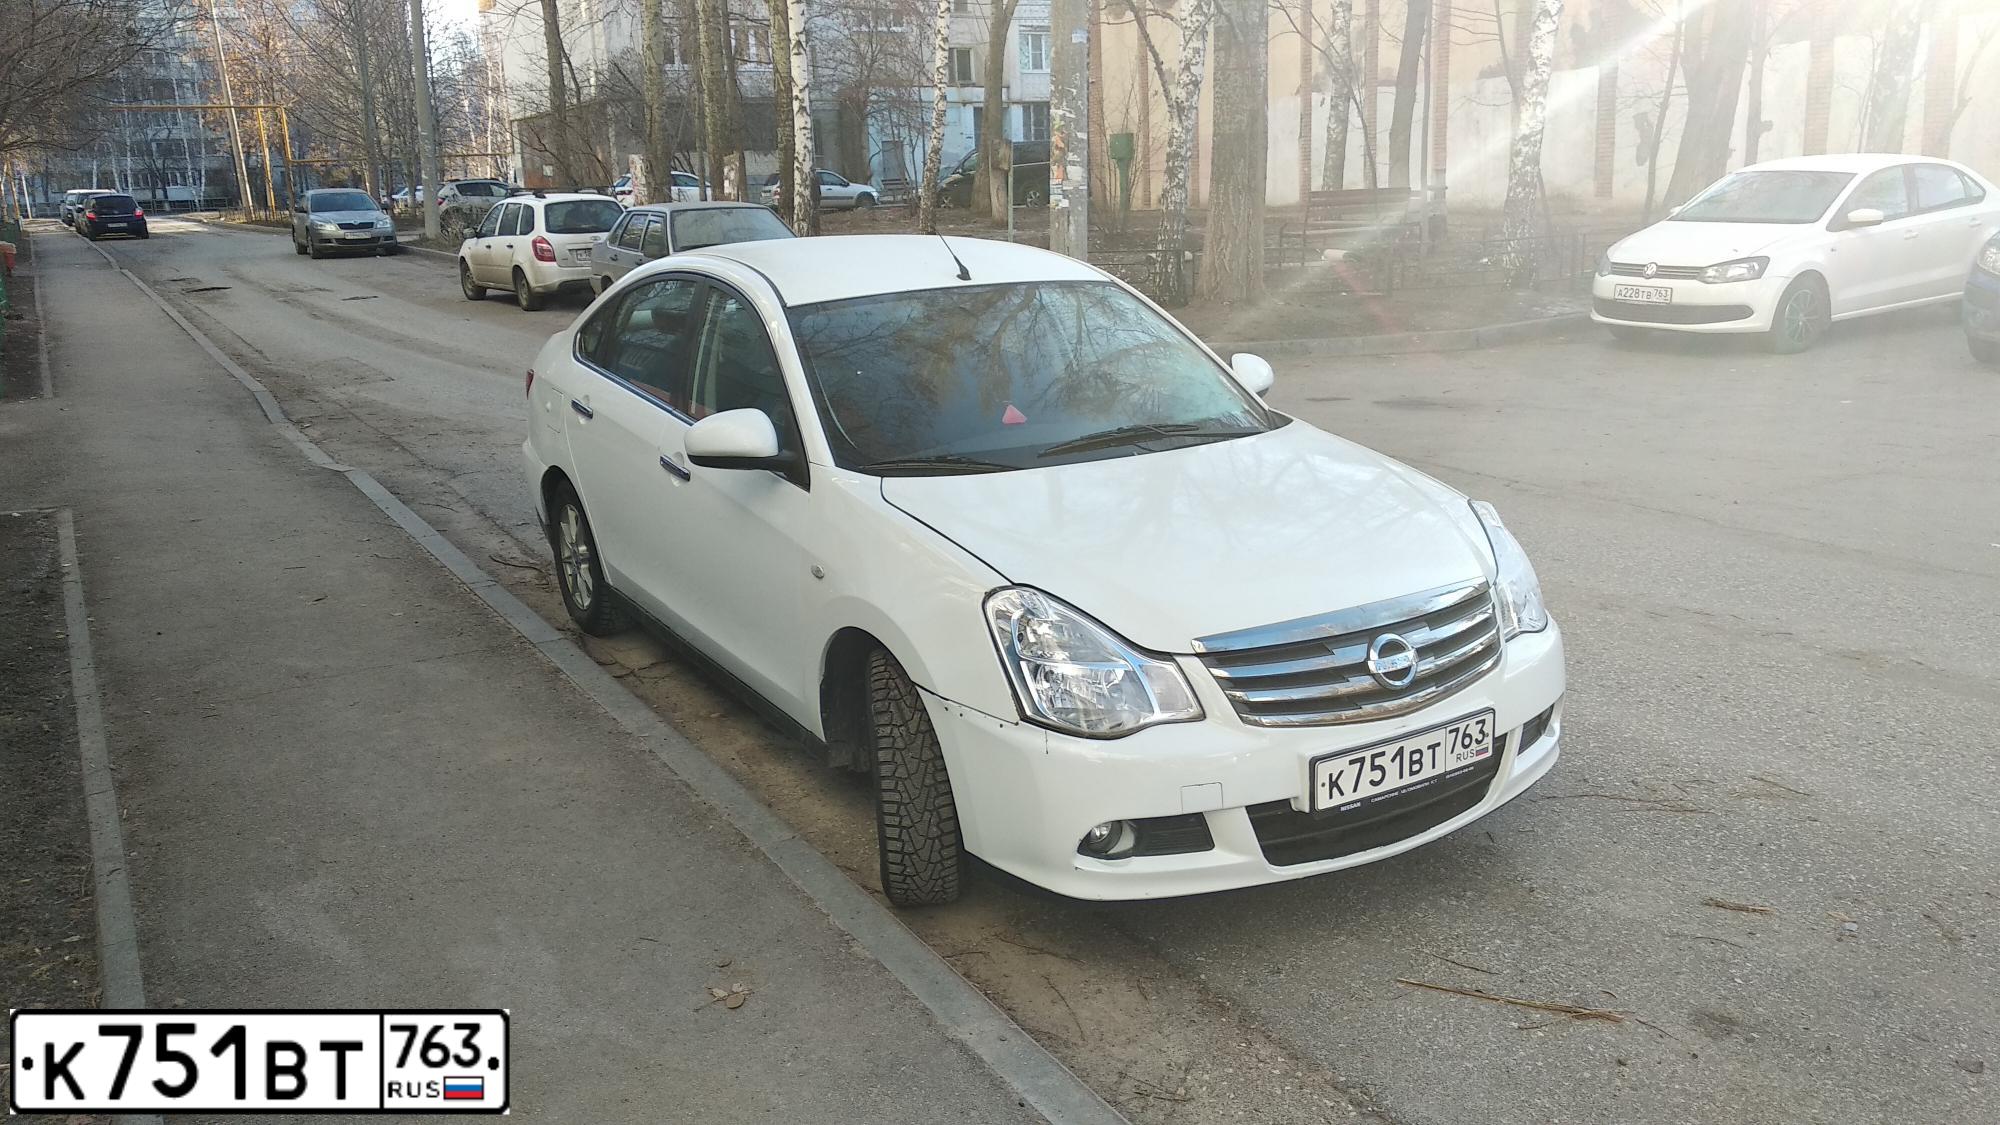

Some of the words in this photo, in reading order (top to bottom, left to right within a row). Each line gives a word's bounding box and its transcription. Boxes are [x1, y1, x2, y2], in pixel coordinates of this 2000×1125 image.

[1328, 742, 1441, 800] К751ВТ
[1449, 719, 1486, 754] 763
[1456, 749, 1475, 763] RUS
